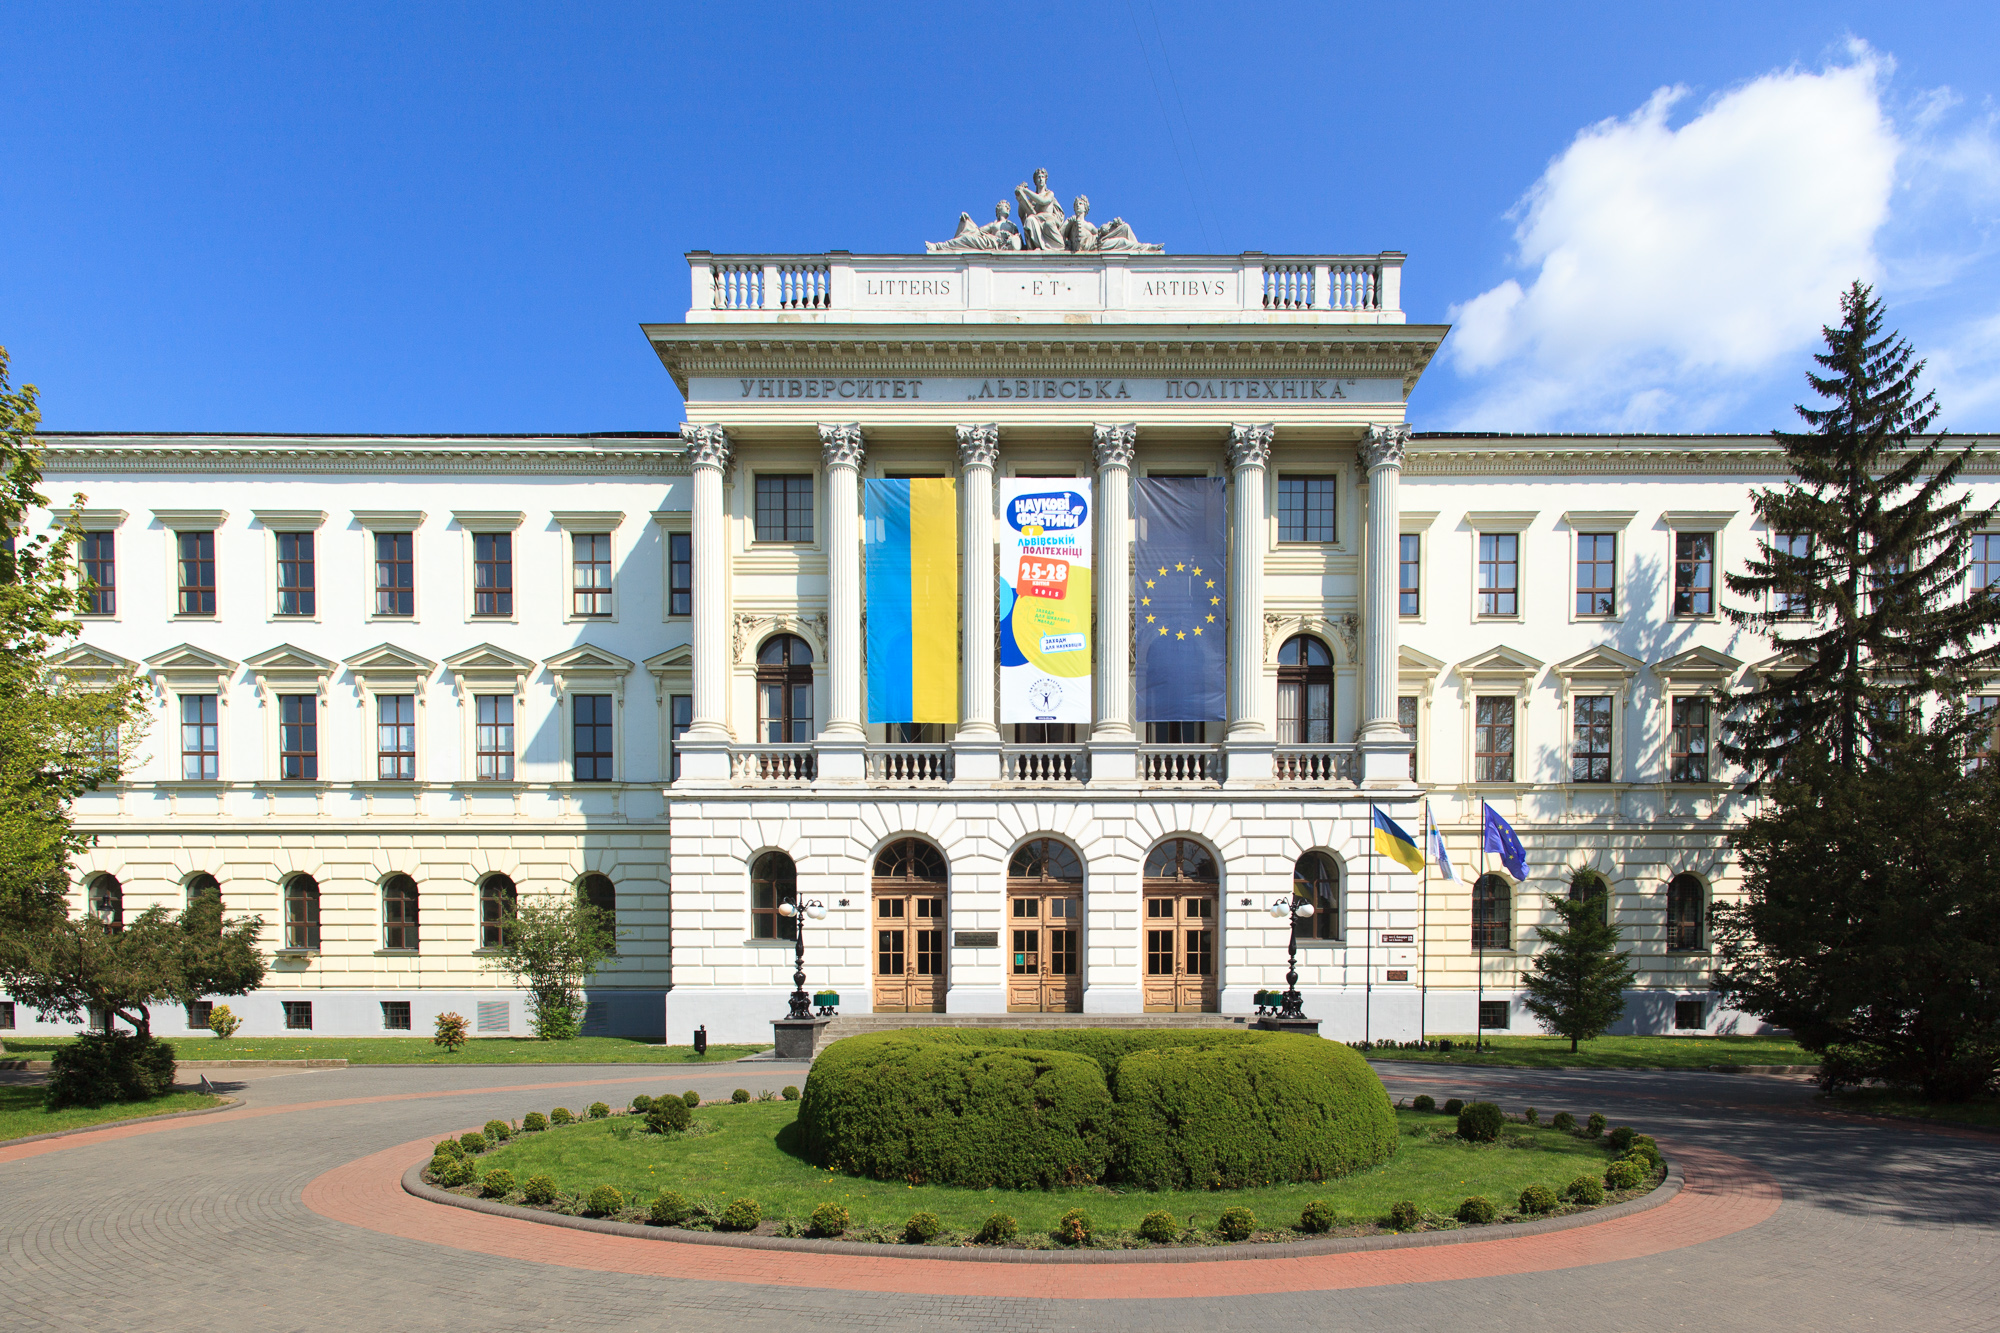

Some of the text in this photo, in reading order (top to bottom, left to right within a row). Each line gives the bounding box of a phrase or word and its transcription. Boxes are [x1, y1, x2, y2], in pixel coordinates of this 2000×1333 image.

[866, 279, 951, 296] LITTERIS
[1142, 279, 1225, 296] ARTIBVS
[739, 378, 924, 399] УНІВЕРСИТЕТ
[1015, 494, 1070, 515] НАУКОВІ
[1016, 512, 1079, 528] ФЕСТИНИ
[1017, 534, 1075, 547] ЛЬВІВСЬКІЙ
[1022, 545, 1083, 558] ПОЛІТЕХНІЦІ
[1021, 562, 1067, 580] 25-28
